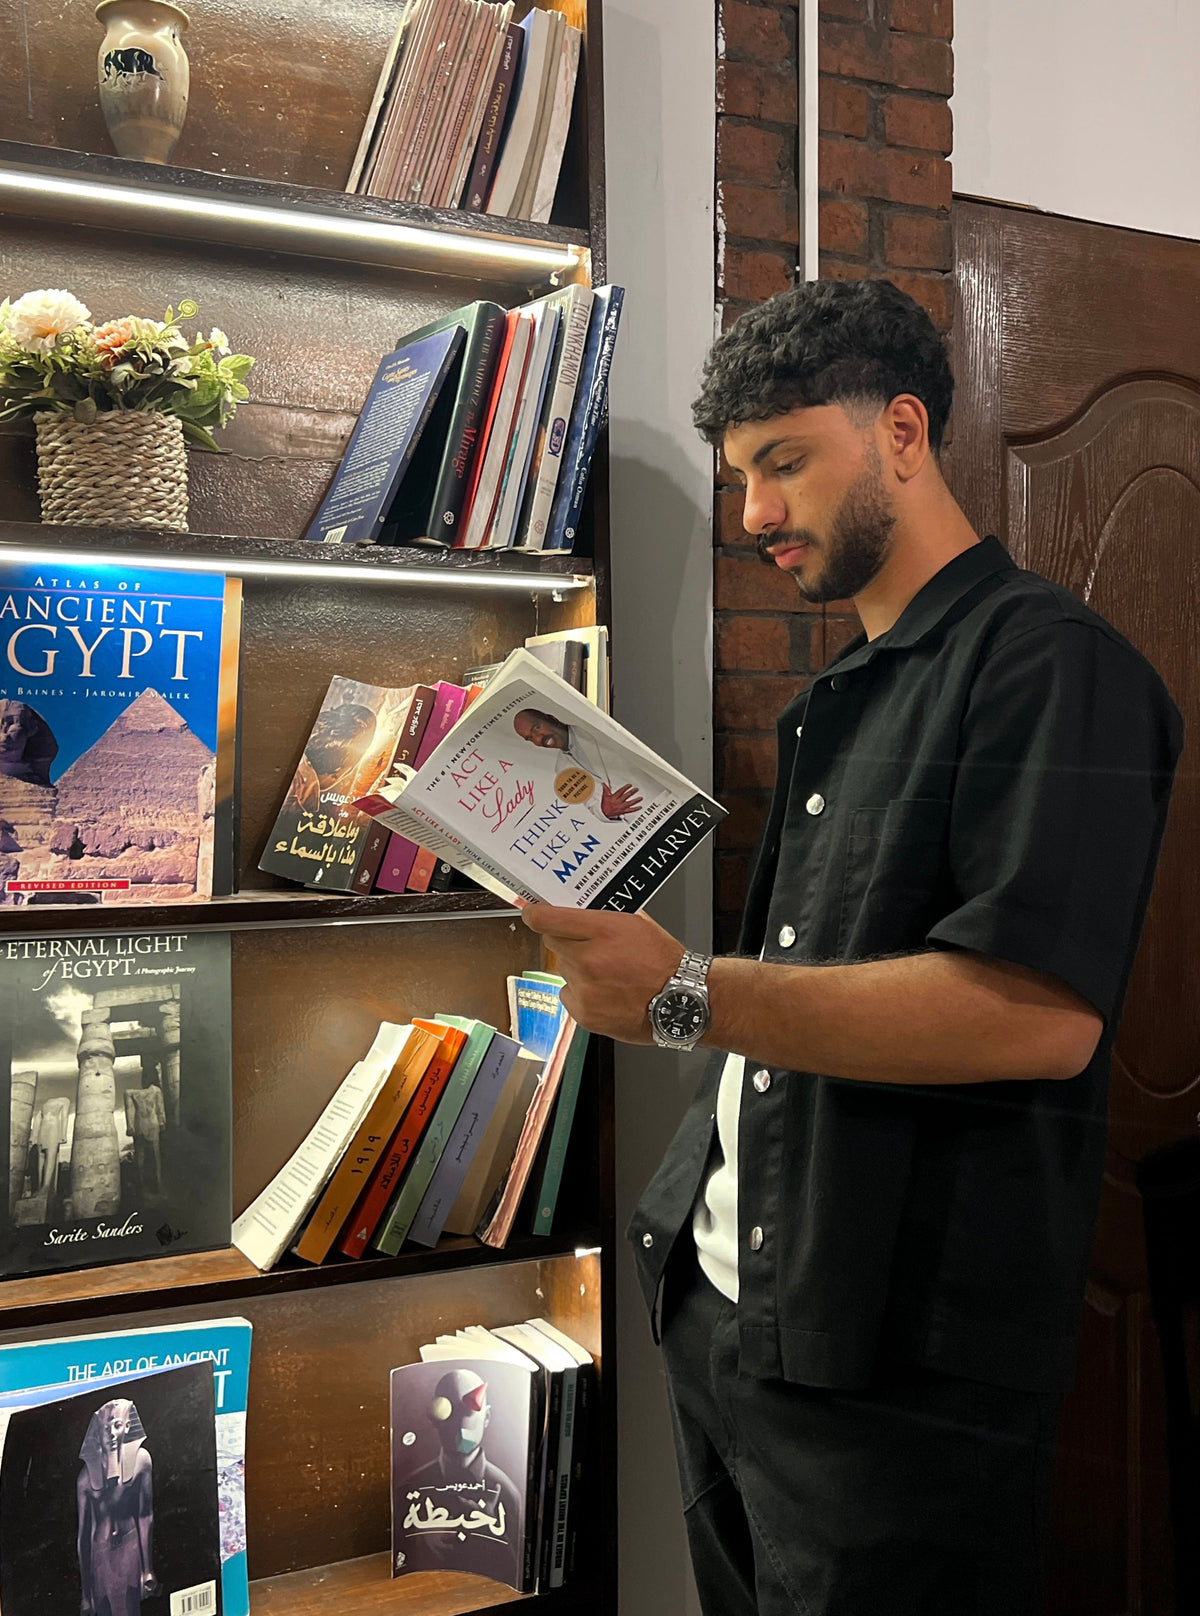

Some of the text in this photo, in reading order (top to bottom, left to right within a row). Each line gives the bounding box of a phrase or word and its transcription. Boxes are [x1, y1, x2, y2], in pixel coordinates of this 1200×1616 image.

[471, 318, 496, 406] NAGUIB MAHFOUZ
[452, 426, 477, 479] Mirage
[35, 576, 141, 591] ATLAS OF
[0, 595, 172, 625] ANCIENT
[7, 623, 203, 681] GYPT
[409, 716, 419, 736] عويس
[426, 777, 441, 793] THE
[451, 746, 467, 764] NEW
[466, 731, 484, 748] YORK
[483, 713, 503, 731] TIMES
[502, 690, 537, 713] BESTSELLER
[450, 748, 485, 788] ACT
[458, 759, 514, 812] LIKE A
[482, 779, 535, 833] Lady
[510, 799, 569, 856] THINK
[635, 828, 648, 842] AND
[646, 800, 678, 831] COMMITMENT
[411, 807, 425, 817] ACT
[425, 816, 439, 829] LIKE
[444, 832, 462, 846] LADY
[463, 846, 482, 862] THINK
[482, 860, 495, 872] LIKE
[501, 876, 515, 888] MAN
[531, 818, 586, 871] LIKE A
[553, 834, 601, 884] MAN
[574, 876, 588, 890] WHAT
[588, 863, 601, 876] MEN
[599, 846, 617, 864] REALLY
[615, 831, 631, 848] THINK
[629, 814, 647, 831] ABOUT
[601, 804, 712, 912] EVE HARVEY
[71, 881, 118, 889] EDITION
[6, 935, 188, 960] ETERNAL LIGHT
[32, 958, 136, 991] of EGYPT
[43, 1211, 144, 1246] Sarite Sanders
[67, 1363, 97, 1382] THE
[102, 1358, 133, 1376] ART
[136, 1356, 158, 1371] OF
[435, 1479, 486, 1492] أحمد عويس
[403, 1490, 506, 1541] لخبطة
